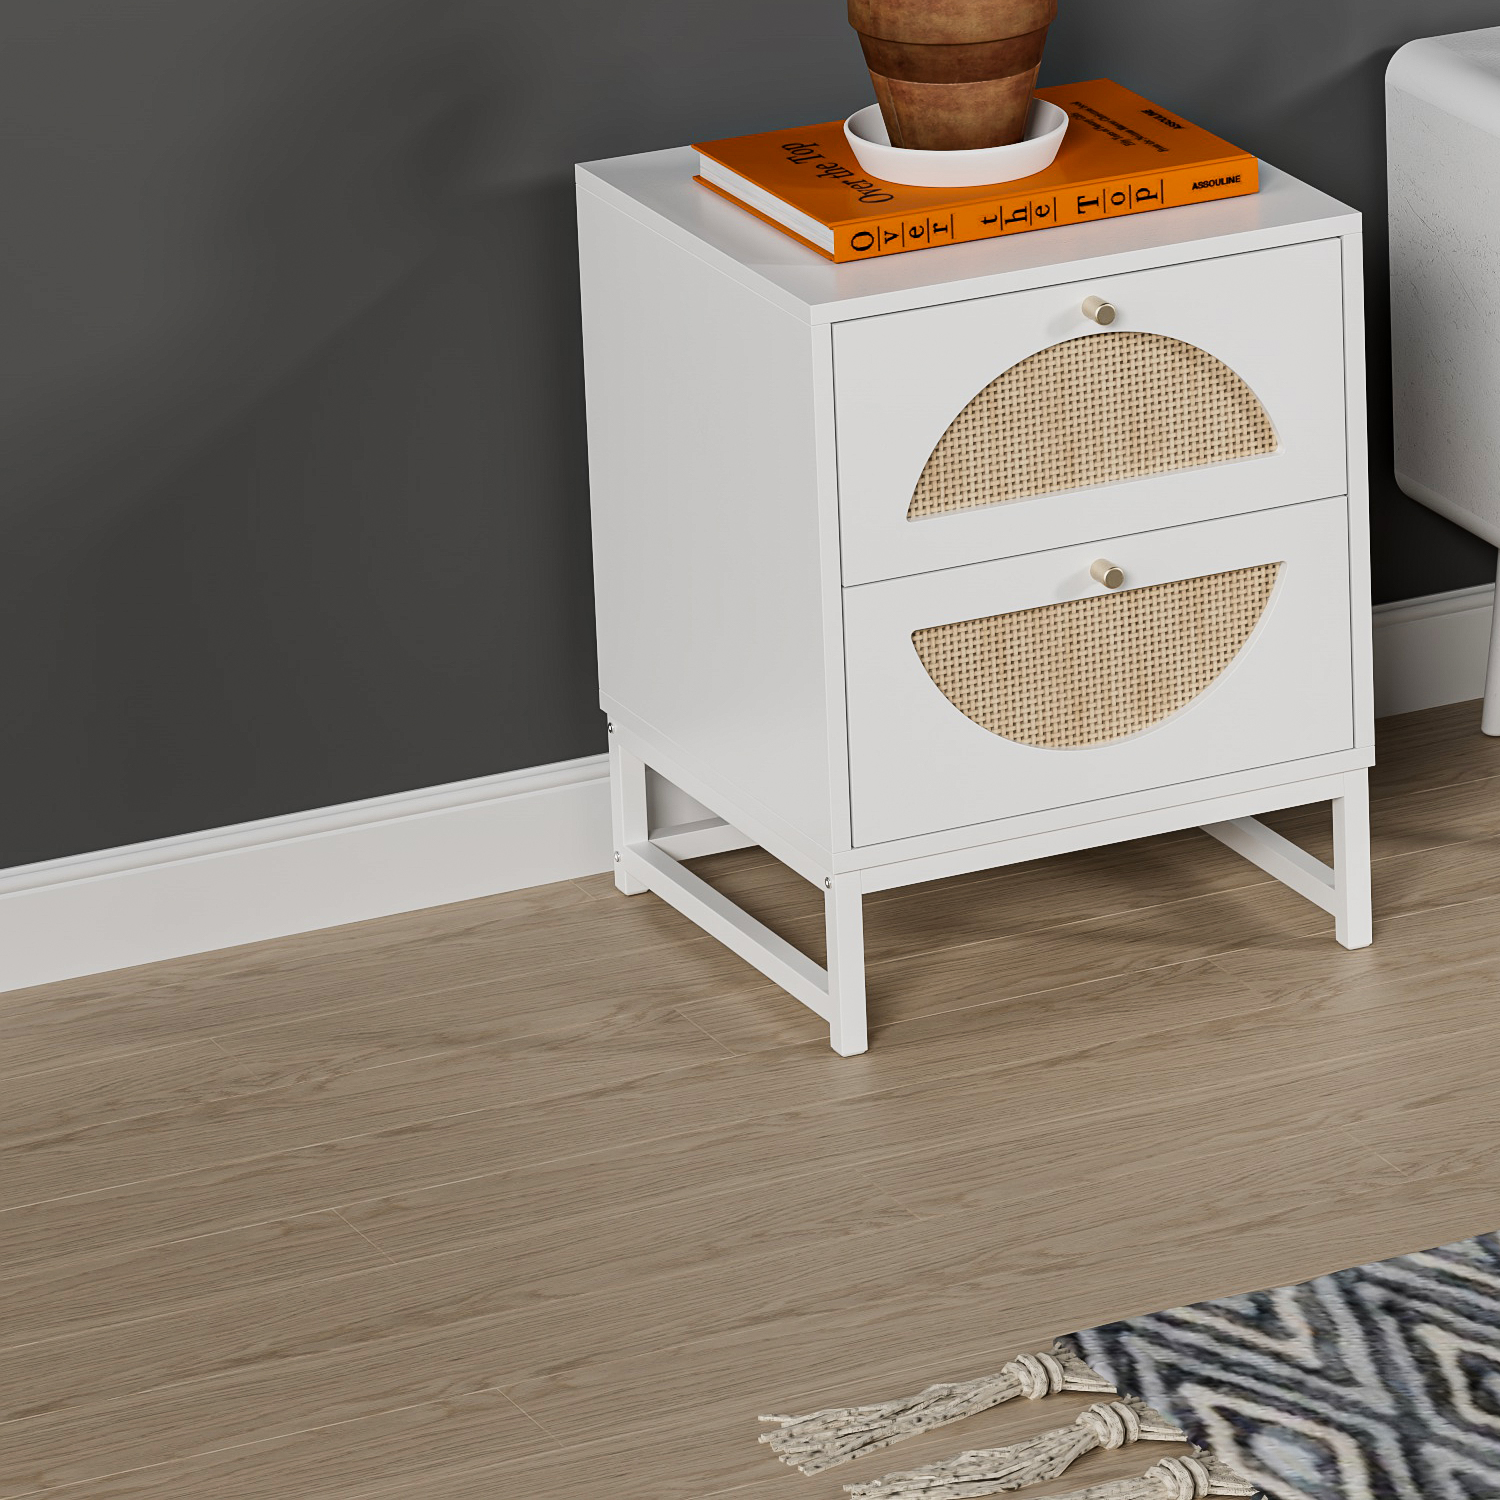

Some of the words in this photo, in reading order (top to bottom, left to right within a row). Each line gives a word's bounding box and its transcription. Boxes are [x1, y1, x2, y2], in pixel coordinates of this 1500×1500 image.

[781, 142, 825, 164] Top
[815, 162, 854, 179] the
[841, 179, 894, 203] Over
[1191, 174, 1241, 191] ASSOULINE
[850, 223, 949, 252] Over
[980, 203, 1051, 226] the
[1076, 187, 1159, 215] Top
